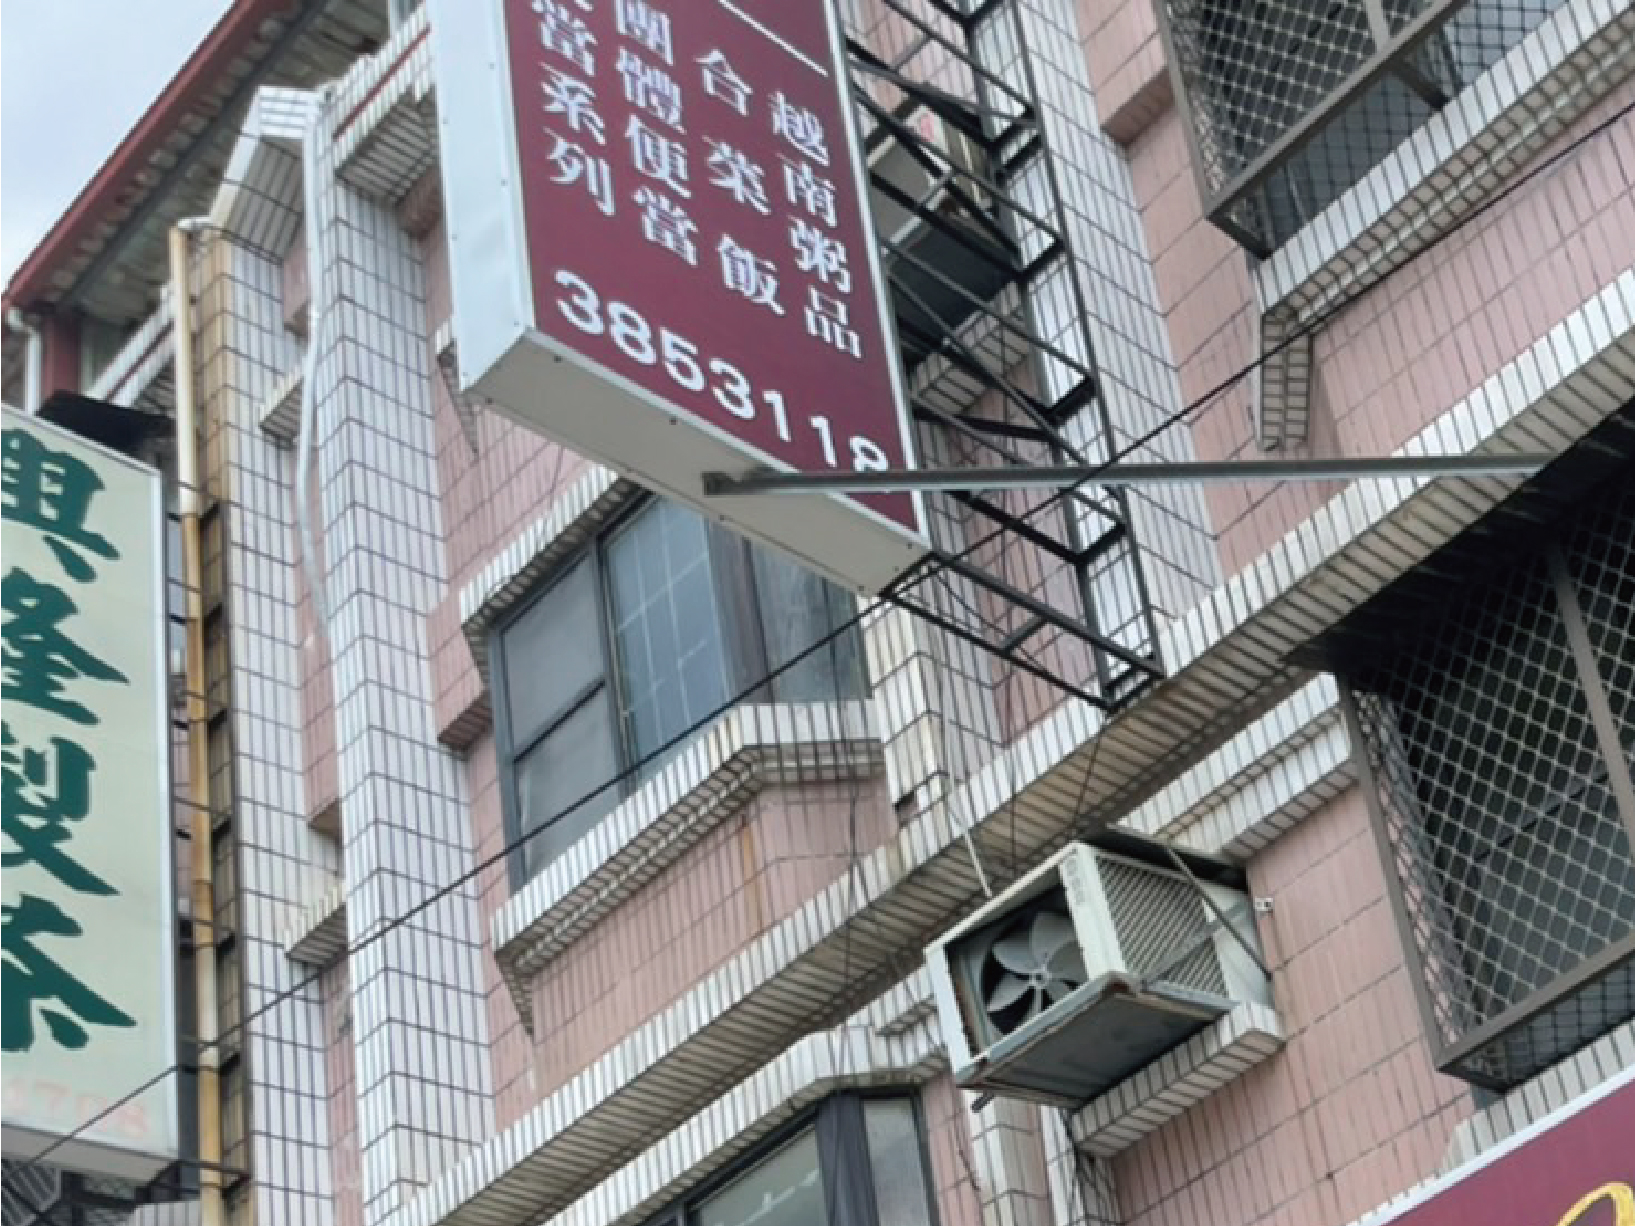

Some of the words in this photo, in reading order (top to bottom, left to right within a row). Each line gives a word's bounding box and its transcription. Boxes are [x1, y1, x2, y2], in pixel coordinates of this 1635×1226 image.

[532, 0, 616, 218] 當系列
[767, 91, 862, 360] 越南粥品
[555, 269, 891, 482] 3853118
